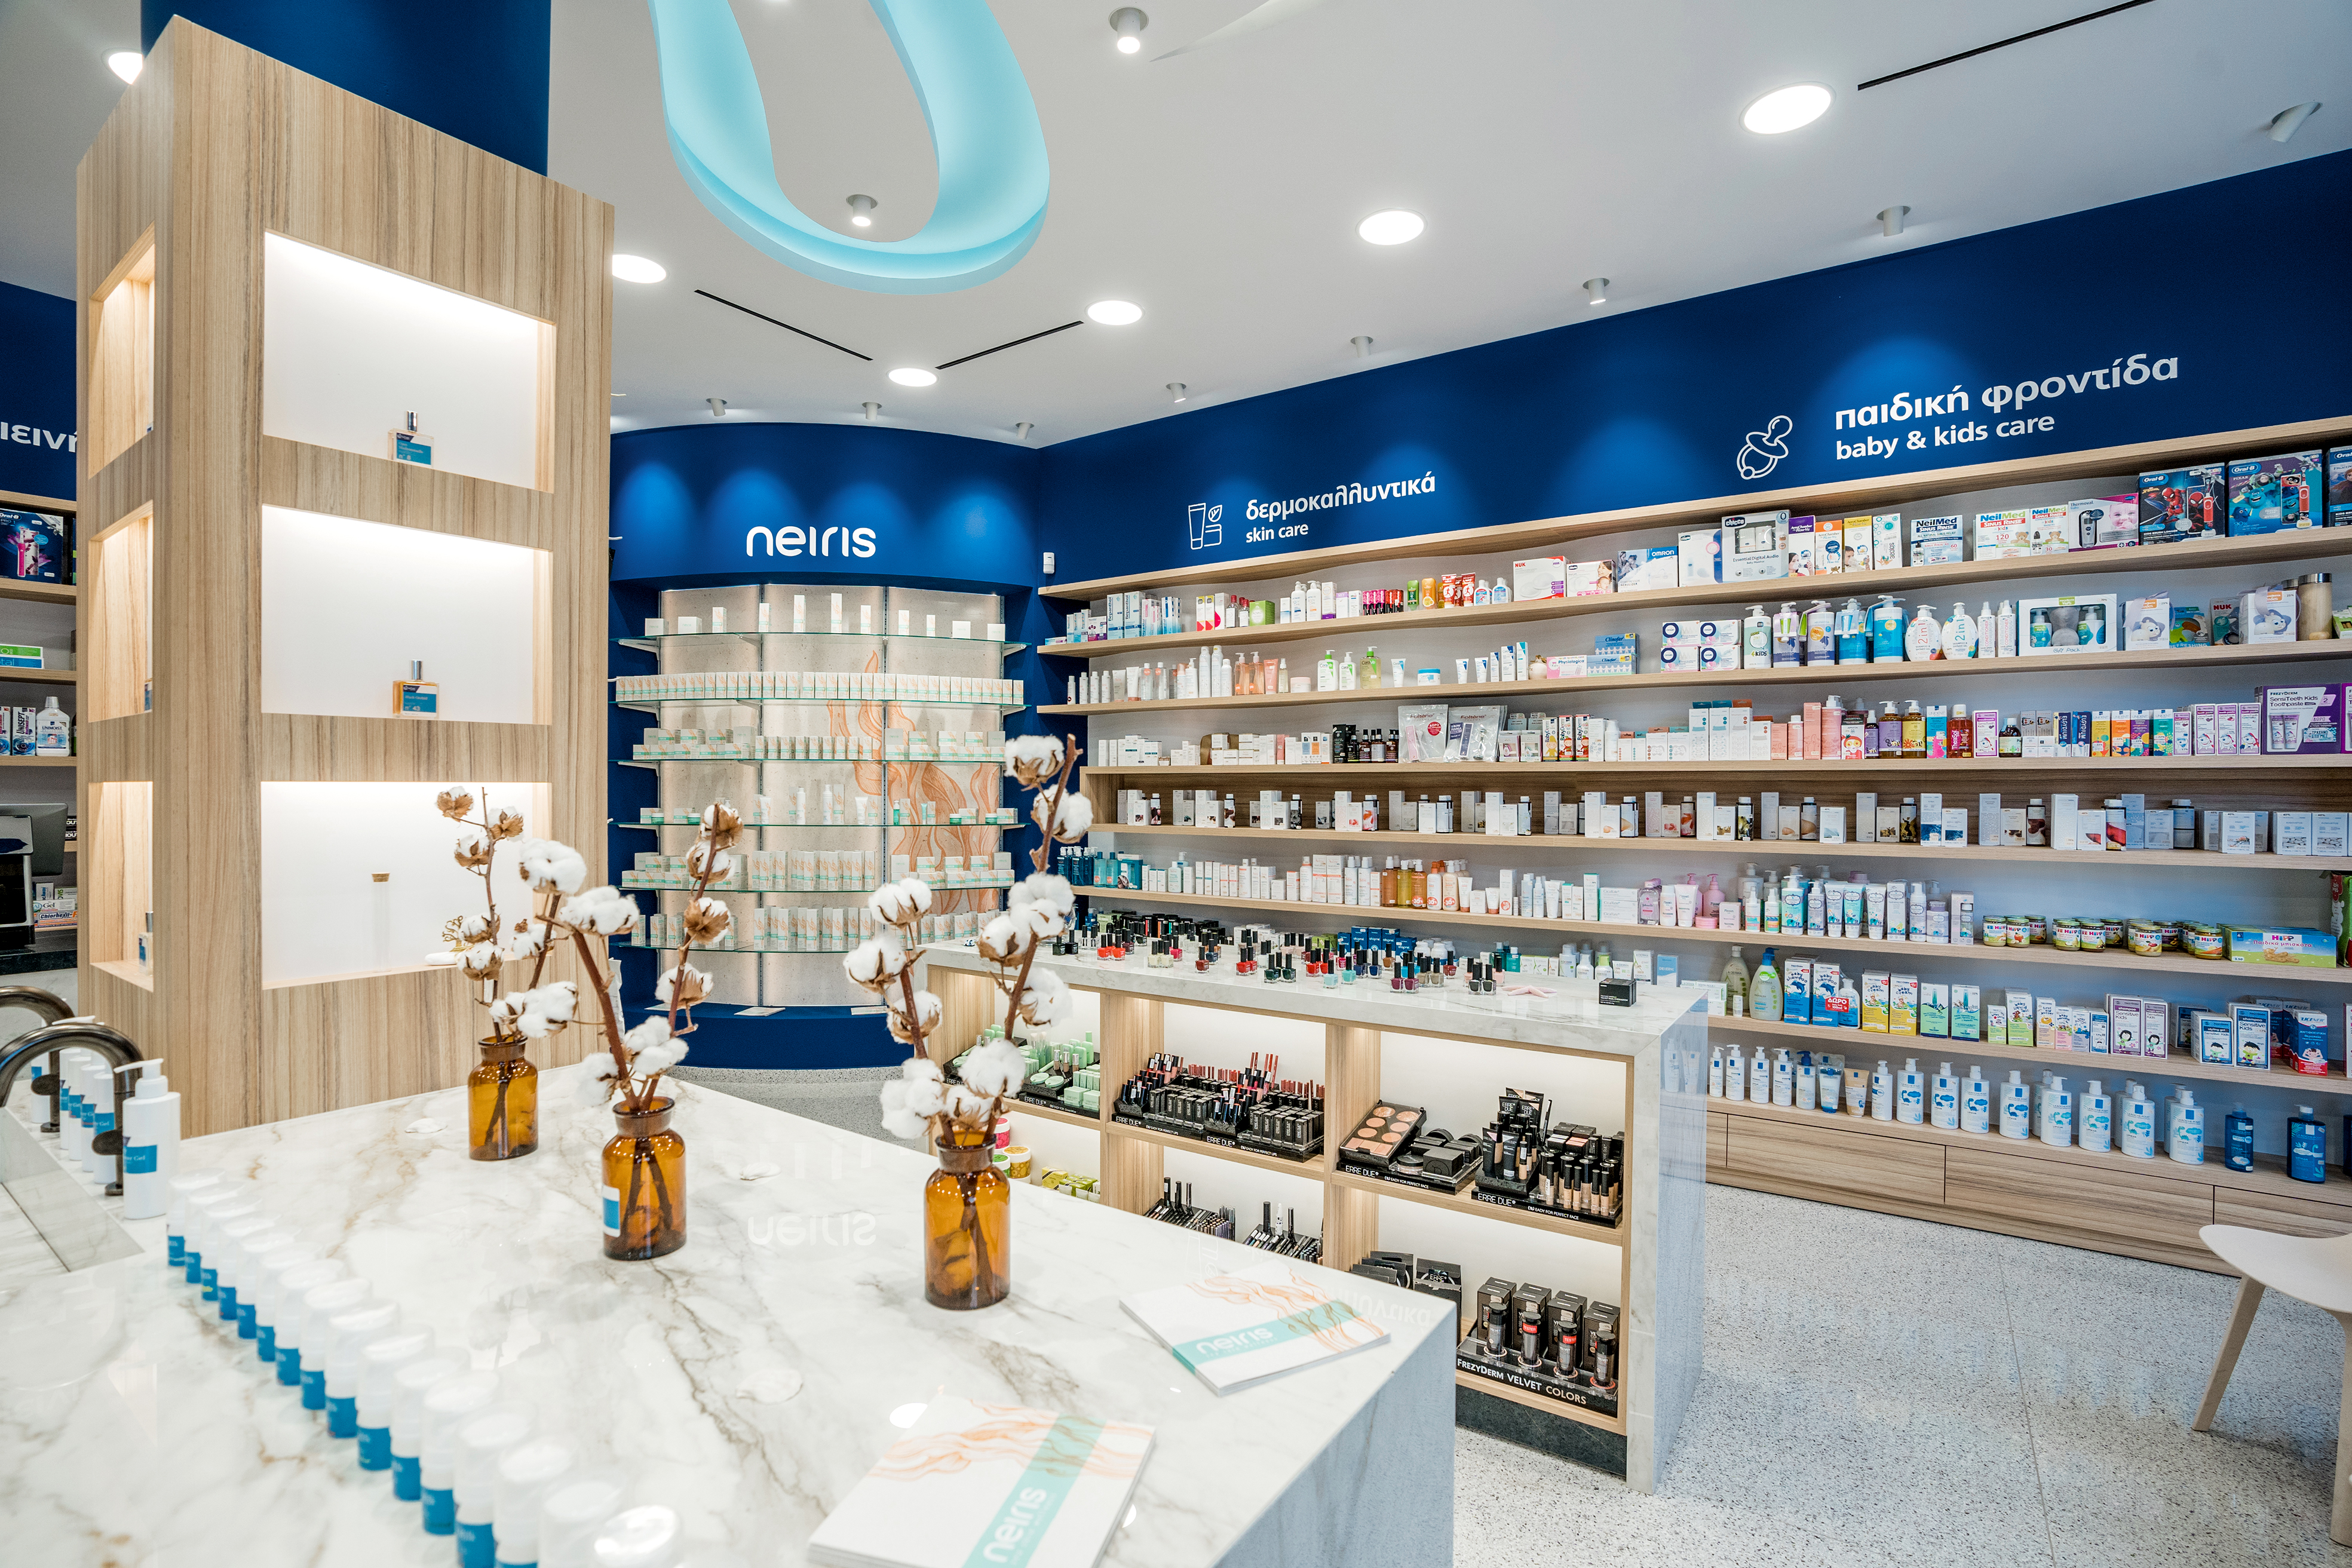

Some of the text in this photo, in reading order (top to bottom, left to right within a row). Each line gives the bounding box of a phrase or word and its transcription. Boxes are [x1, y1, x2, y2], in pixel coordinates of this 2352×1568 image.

[1836, 354, 2178, 429] παιδική φροντίδα
[1836, 413, 2054, 461] baby & kids care
[2234, 465, 2255, 474] Oral-B
[1246, 471, 1435, 522] δερμοκαλλυντικά
[1980, 511, 2025, 522] NeilMed
[2032, 506, 2066, 515] NeilMed
[1725, 518, 1744, 527] chicco
[1916, 517, 1957, 527] NeilMed
[747, 526, 876, 558] neiris
[1246, 524, 1308, 543] skin care
[16, 712, 25, 734] UNISEPT
[1207, 1136, 1221, 1144] ERRE
[1346, 1165, 1375, 1177] ERRE DUE
[1478, 1193, 1512, 1207] ERRE DUE
[1196, 1328, 1273, 1354] neiris
[1457, 1358, 1587, 1404] FREZYDERM VELVET COLORS
[983, 1487, 1047, 1563] neiris
